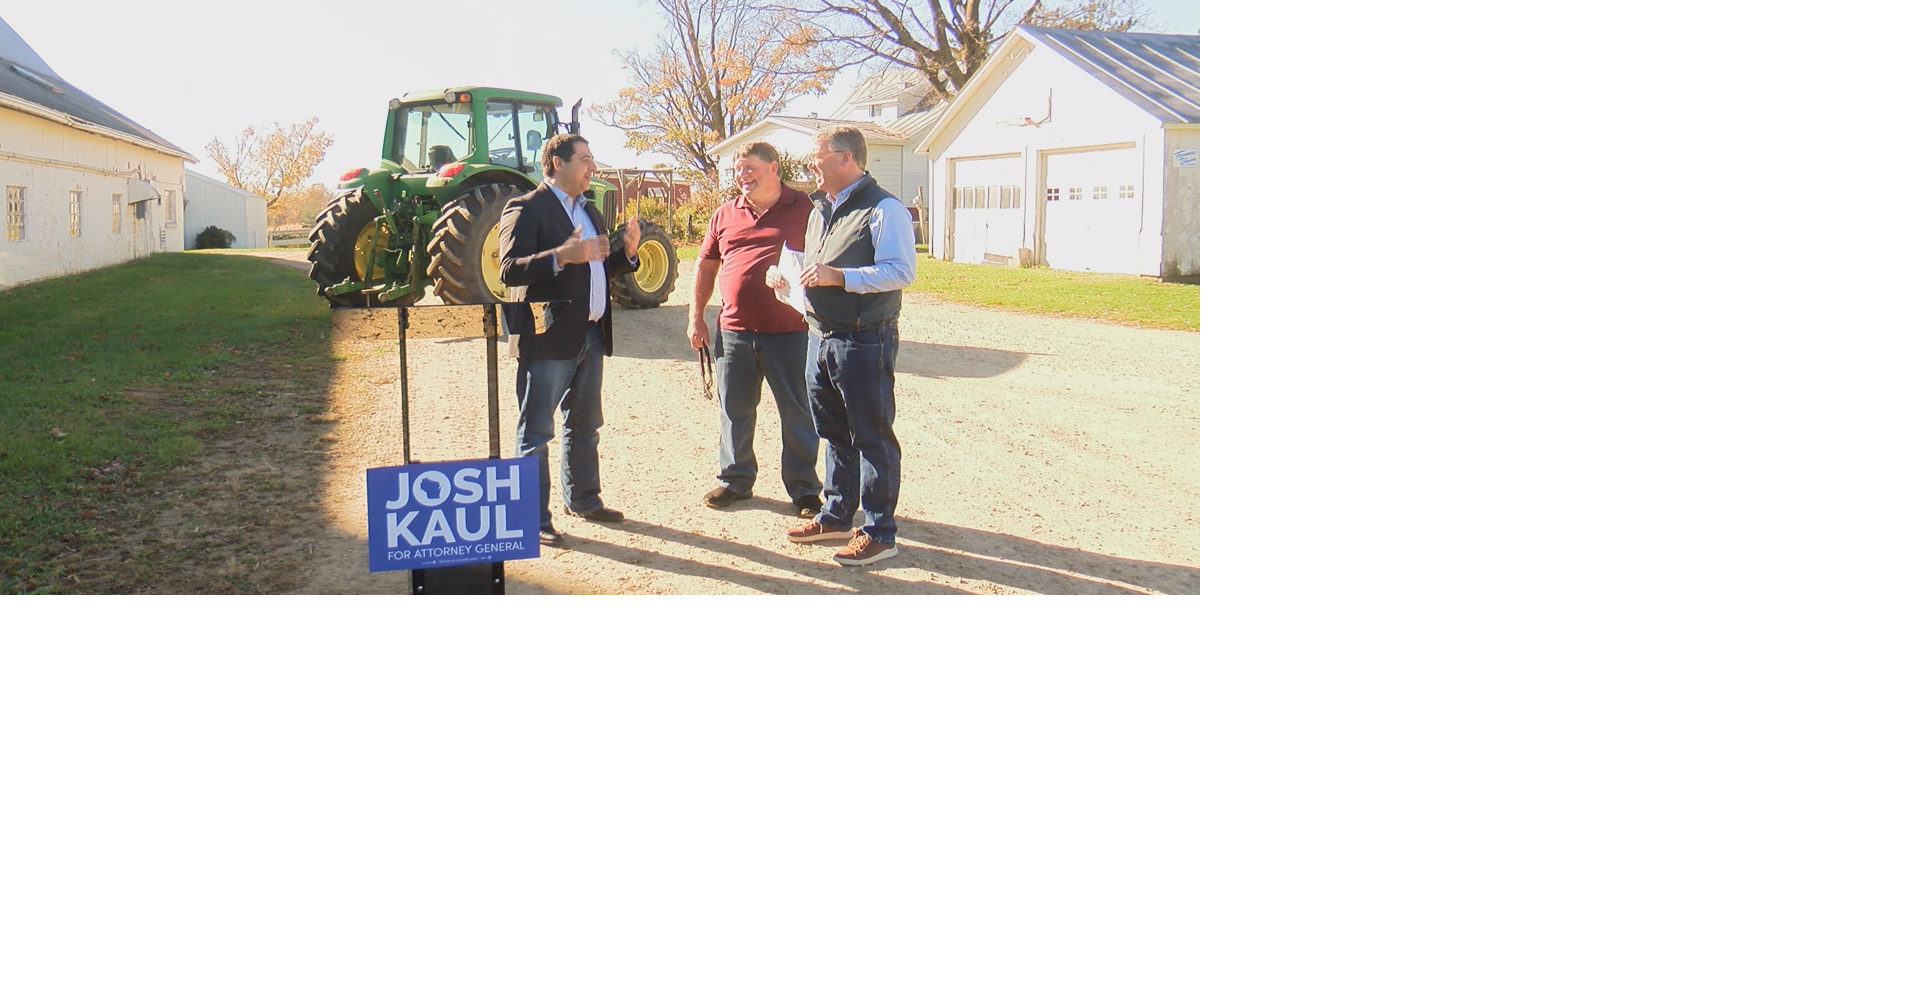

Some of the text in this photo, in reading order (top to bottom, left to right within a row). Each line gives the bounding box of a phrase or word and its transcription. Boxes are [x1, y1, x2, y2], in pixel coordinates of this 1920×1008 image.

[386, 465, 520, 510] JOSH
[387, 504, 523, 548] KAUL
[388, 541, 525, 560] FOR ATTORNEY GENERAL
